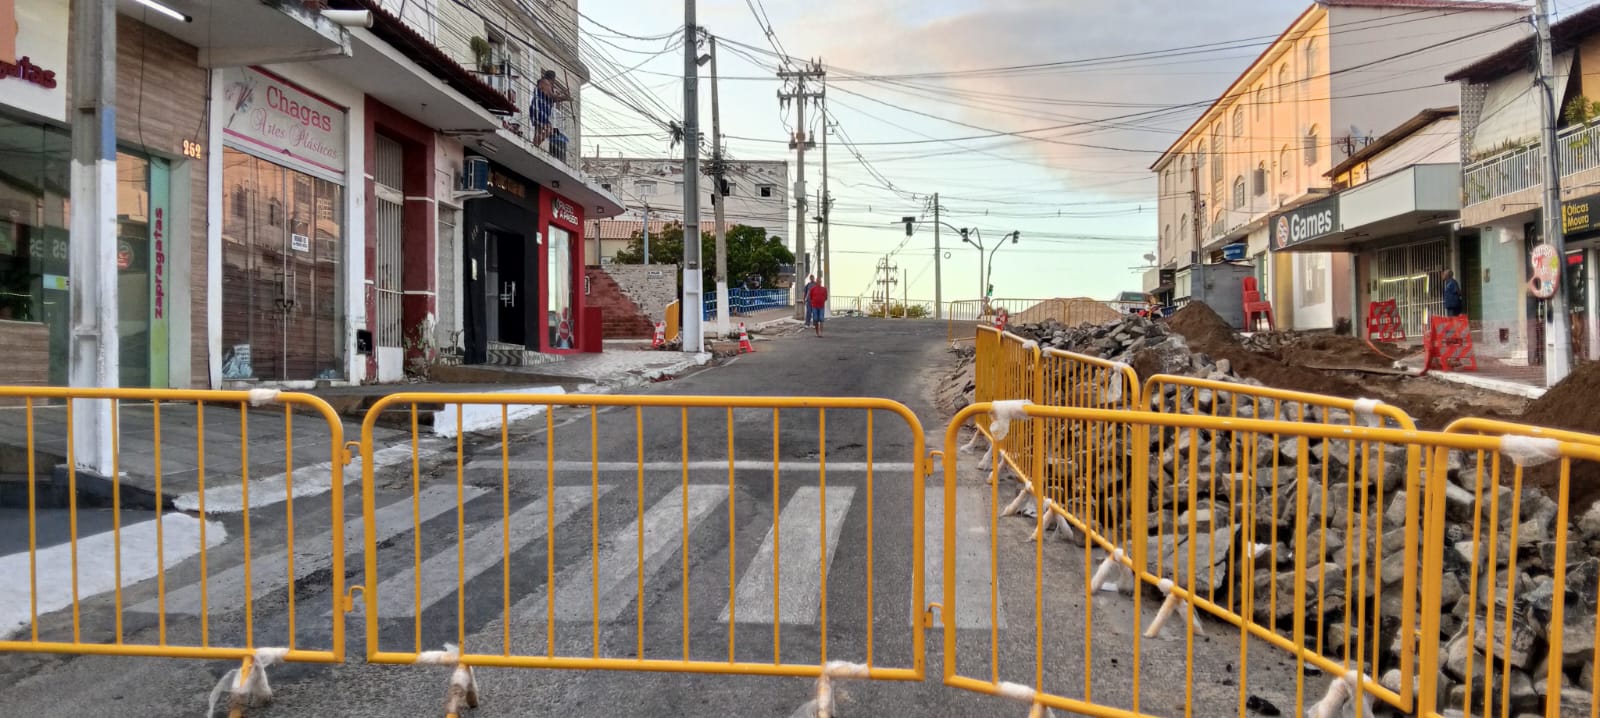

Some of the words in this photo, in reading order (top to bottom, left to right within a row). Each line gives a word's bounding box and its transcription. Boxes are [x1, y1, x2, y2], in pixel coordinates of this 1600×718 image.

[266, 85, 331, 132] Chagas
[183, 139, 201, 159] 262
[250, 107, 286, 137] Artes
[289, 124, 337, 159] Plásticas
[1291, 210, 1332, 241] Games
[1567, 203, 1589, 216] Óticas
[154, 207, 165, 319] zapragatas
